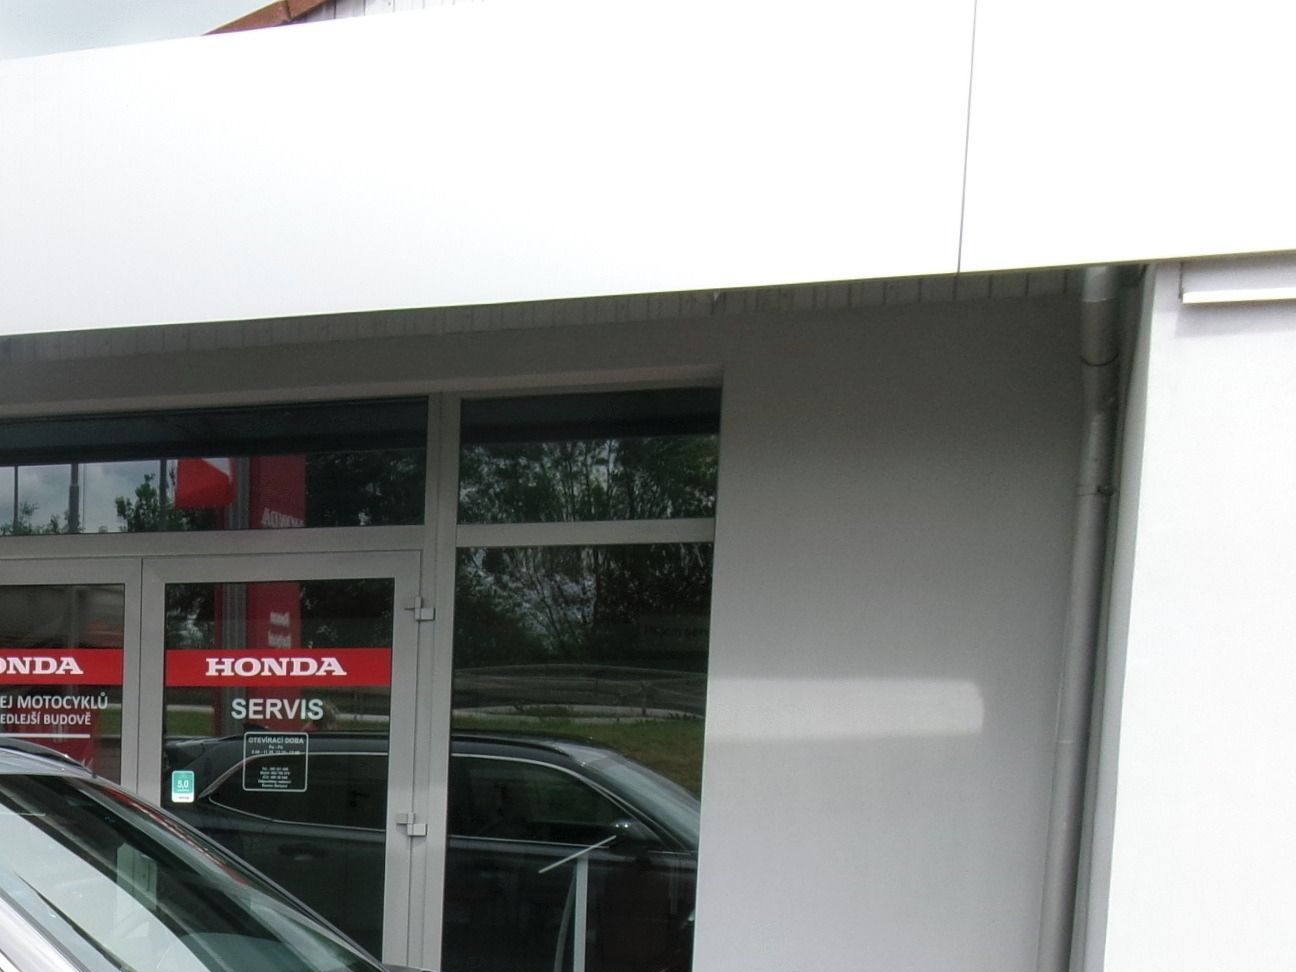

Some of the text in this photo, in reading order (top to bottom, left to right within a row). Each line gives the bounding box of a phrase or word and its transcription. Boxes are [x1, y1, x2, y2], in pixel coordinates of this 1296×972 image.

[206, 657, 347, 676] HONDA
[17, 691, 108, 710] MOTOCYKLŮ
[231, 698, 324, 720] SERVIS
[44, 711, 91, 726] BUDOVĚ
